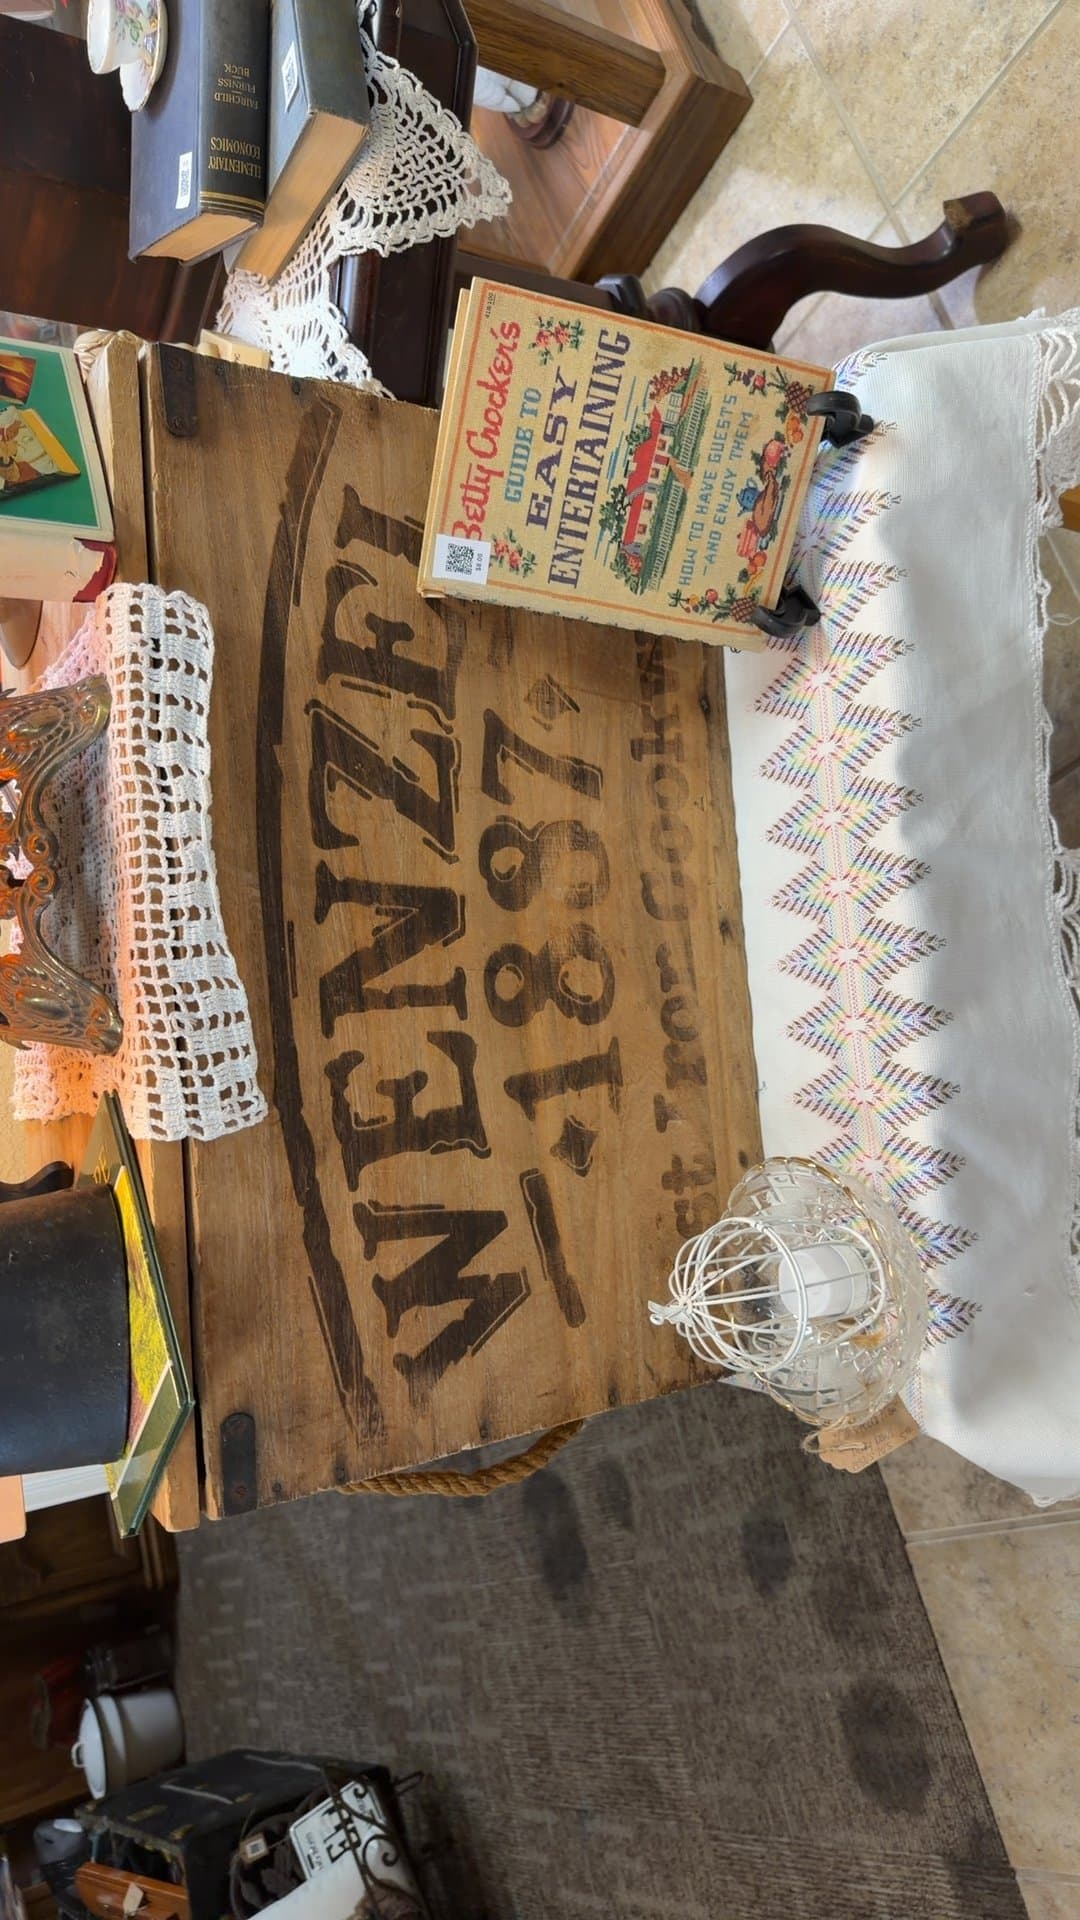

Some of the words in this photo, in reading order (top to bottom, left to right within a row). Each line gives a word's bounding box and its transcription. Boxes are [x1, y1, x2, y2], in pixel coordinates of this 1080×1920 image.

[217, 78, 256, 93] FURNISS
[223, 63, 249, 76] BUCK
[214, 93, 258, 109] FAIRCHILD
[208, 156, 260, 178] ELEMENTARY
[210, 137, 260, 159] ECONOMICS
[466, 319, 521, 461] Crocker's
[518, 387, 543, 419] TO
[525, 365, 577, 531] EASY
[706, 394, 738, 464] GUESTS
[504, 425, 535, 501] GUIDE
[547, 328, 631, 589] ENTERTAINING
[713, 467, 738, 526] ENJOY
[728, 411, 753, 461] THEM
[451, 463, 504, 541] Betty
[698, 470, 718, 515] HAVE
[688, 522, 705, 541] TO
[679, 547, 698, 586] HOW
[630, 634, 697, 921] Cookw
[477, 708, 623, 1123] 1887
